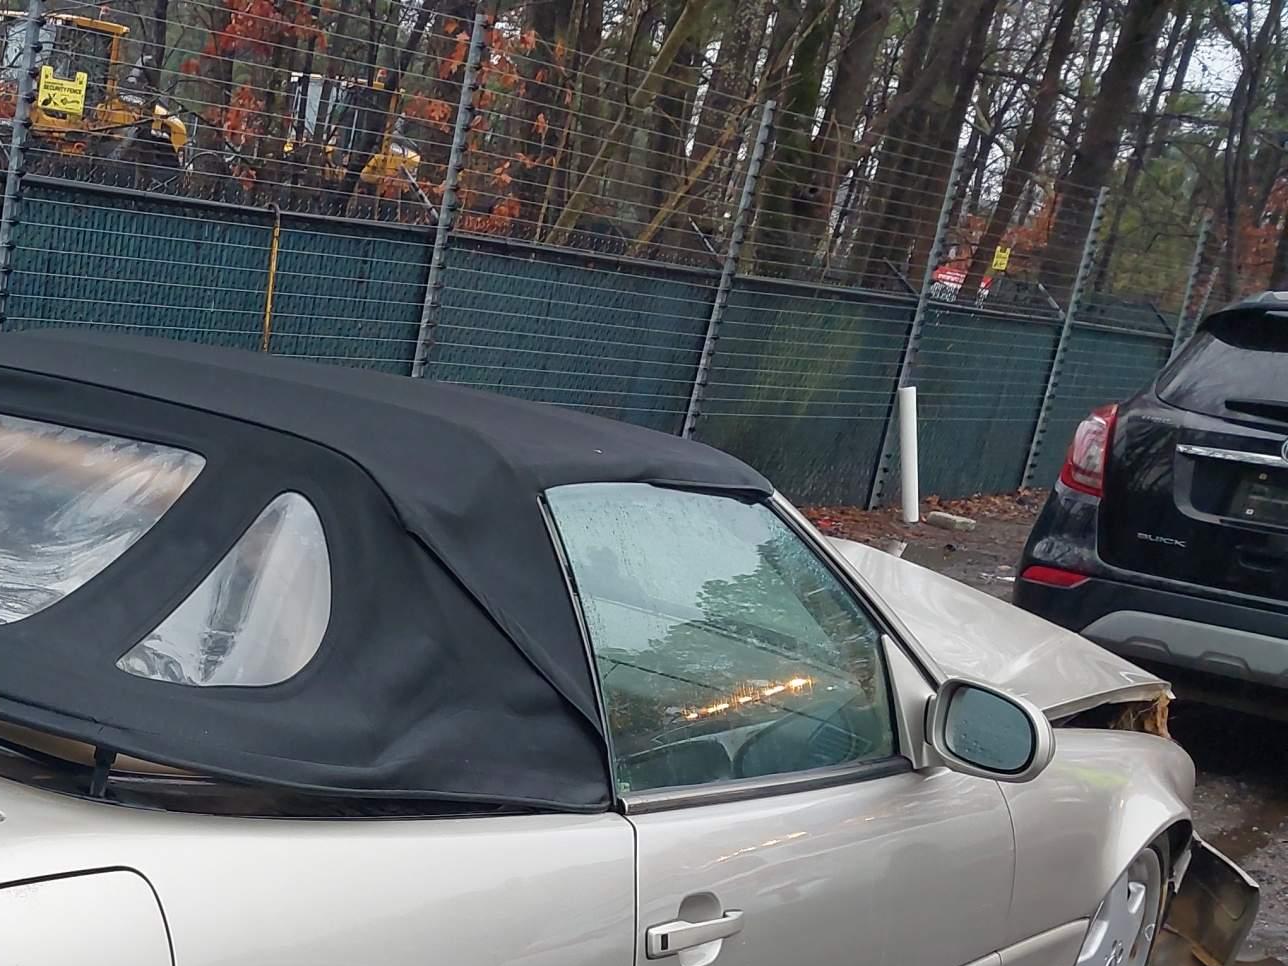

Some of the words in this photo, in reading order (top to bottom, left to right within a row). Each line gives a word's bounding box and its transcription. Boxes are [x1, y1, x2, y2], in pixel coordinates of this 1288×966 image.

[43, 84, 67, 92] SECURITY
[67, 87, 82, 95] FENCE
[1136, 532, 1187, 548] BUICK
